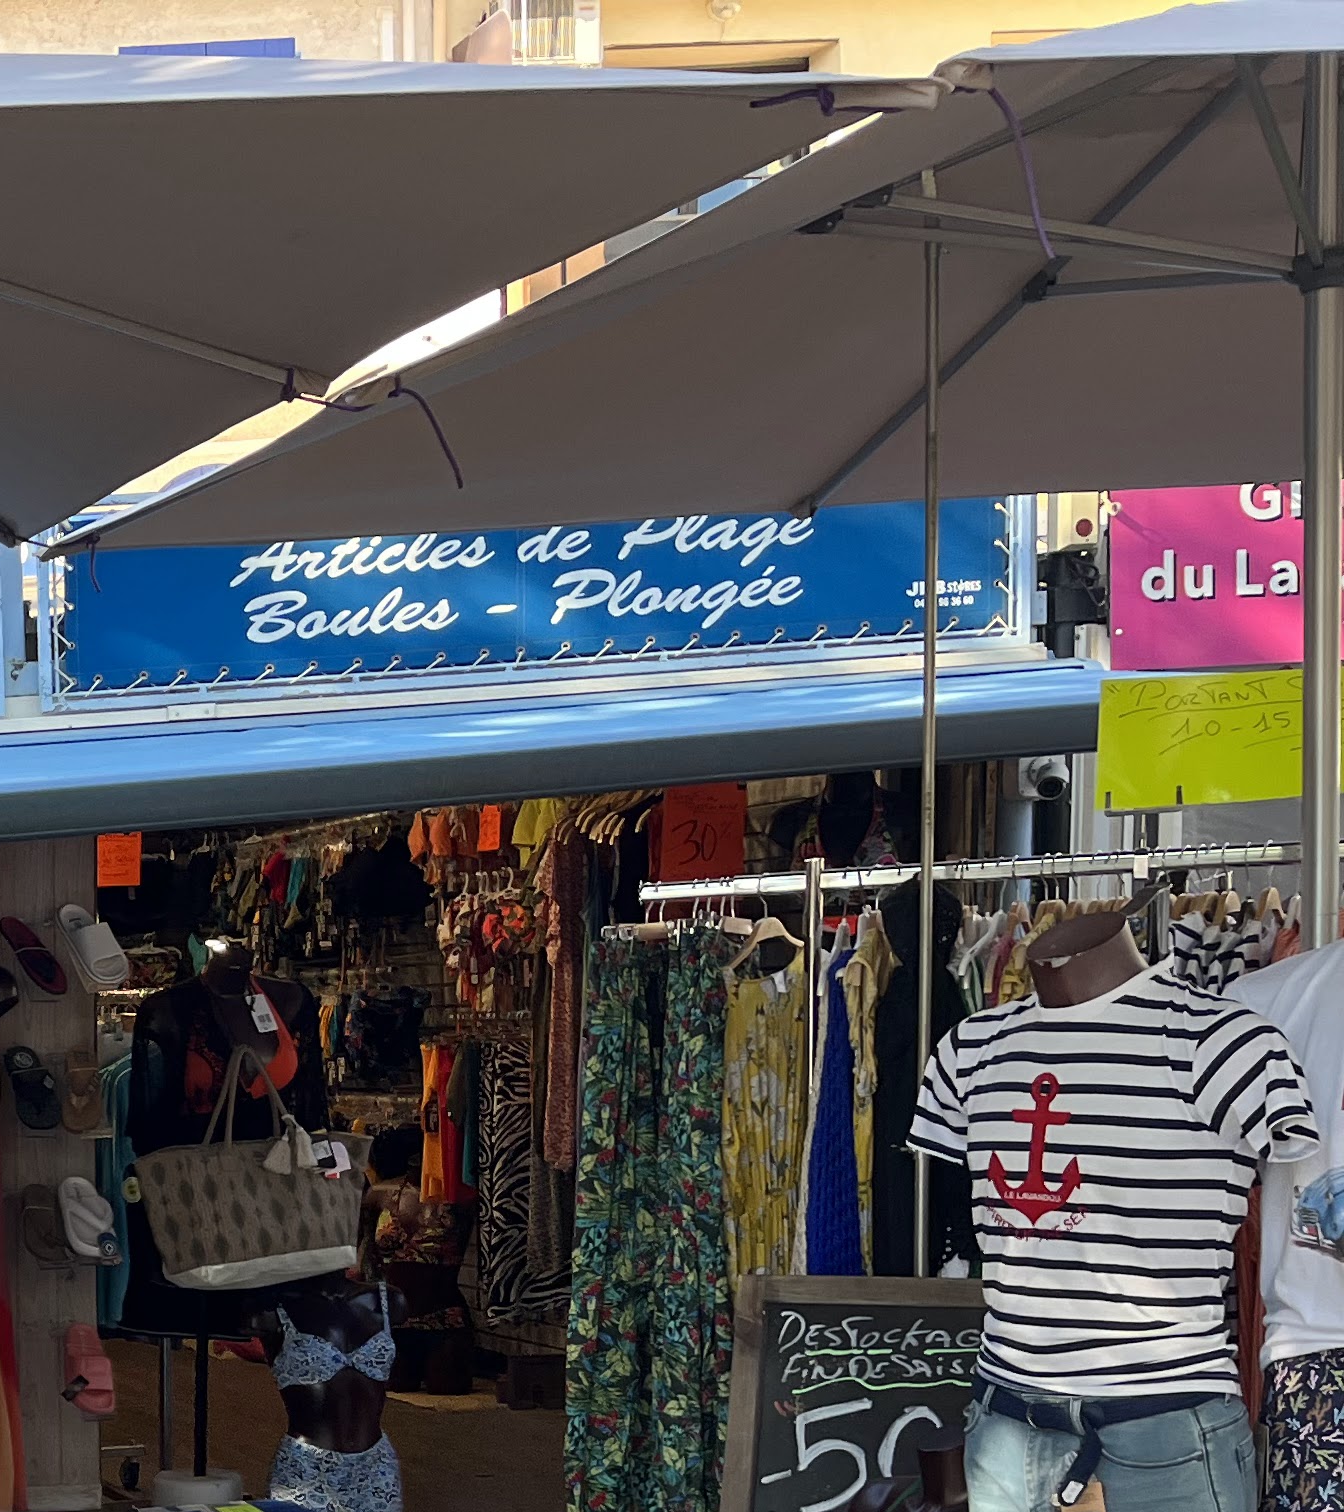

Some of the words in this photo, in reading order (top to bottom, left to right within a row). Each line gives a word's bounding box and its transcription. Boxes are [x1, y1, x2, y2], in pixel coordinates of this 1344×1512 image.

[230, 532, 495, 588] Articles
[517, 525, 591, 564] de
[1141, 550, 1214, 601] du
[242, 587, 459, 644] Boules
[550, 566, 805, 628] Plongée
